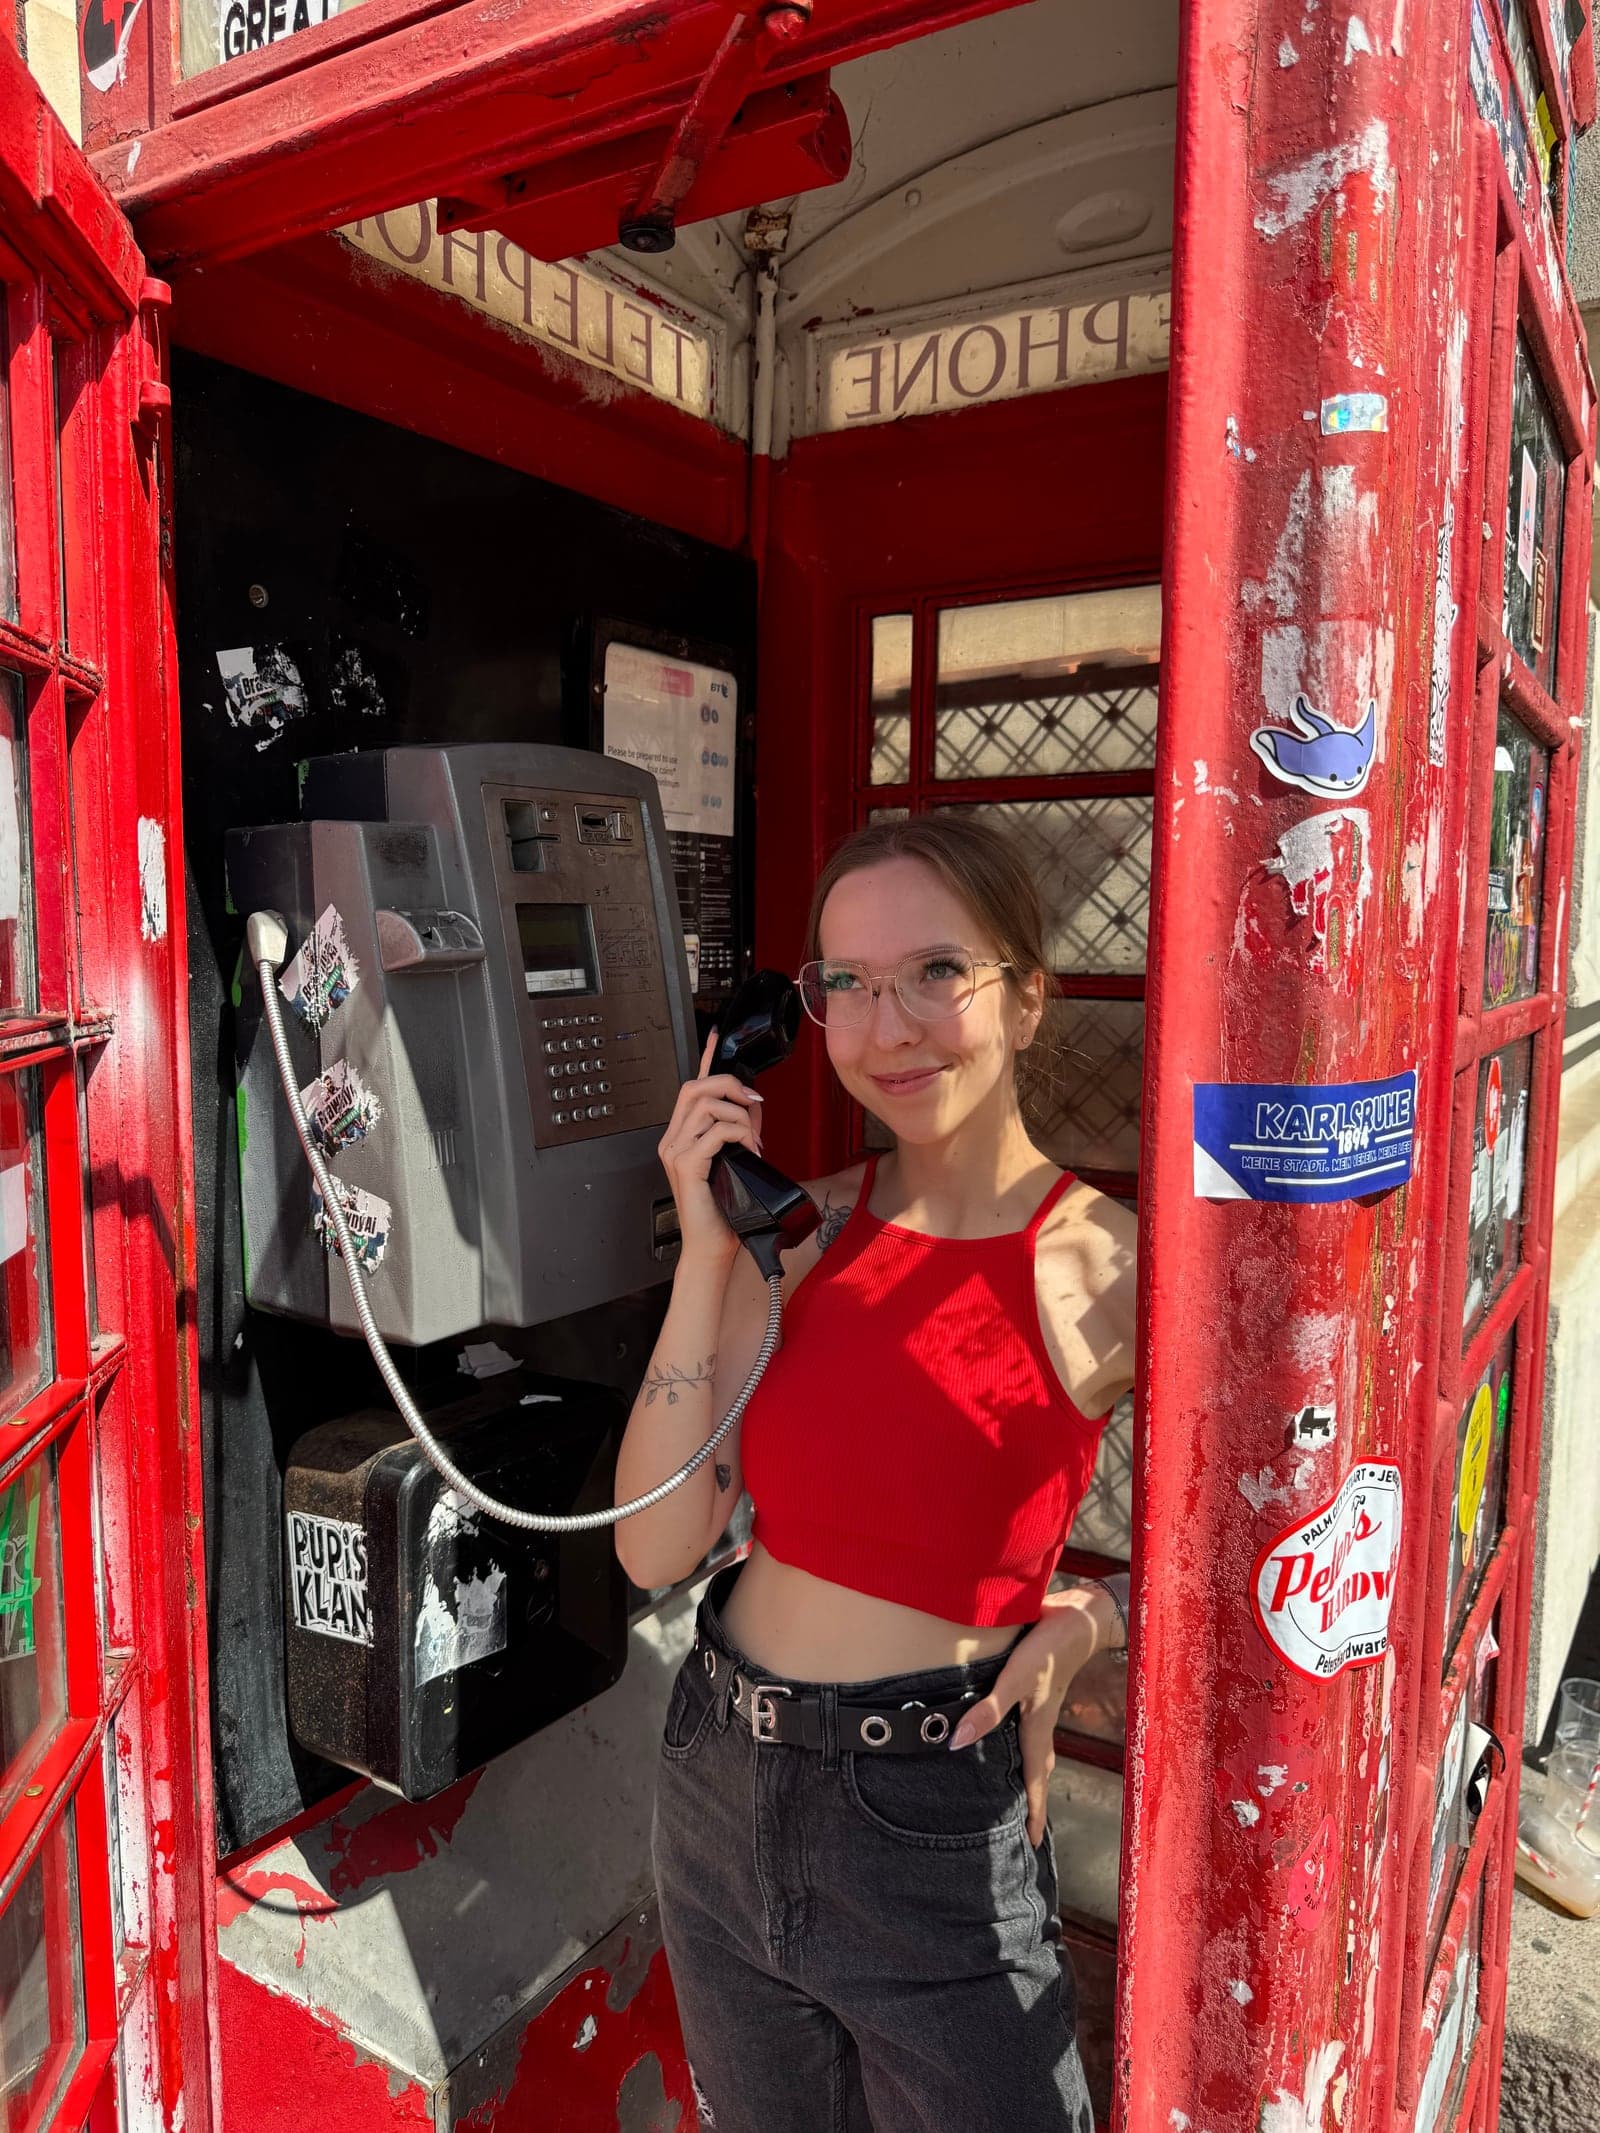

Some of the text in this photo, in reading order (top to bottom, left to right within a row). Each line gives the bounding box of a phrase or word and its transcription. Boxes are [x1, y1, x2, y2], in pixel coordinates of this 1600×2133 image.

[224, 0, 329, 61] GREA
[607, 745, 627, 759] Please
[628, 748, 636, 759] be
[636, 748, 662, 764] prepared
[1256, 1089, 1412, 1141] KARLSRUHE
[1337, 1124, 1370, 1155] 1894
[1242, 1155, 1280, 1170] MEINE
[1283, 1157, 1330, 1173] STADT.
[1332, 1156, 1351, 1172] MEIN
[1377, 1146, 1398, 1161] MEINE
[1301, 1515, 1333, 1546] PALM
[296, 1570, 368, 1636] KLAN
